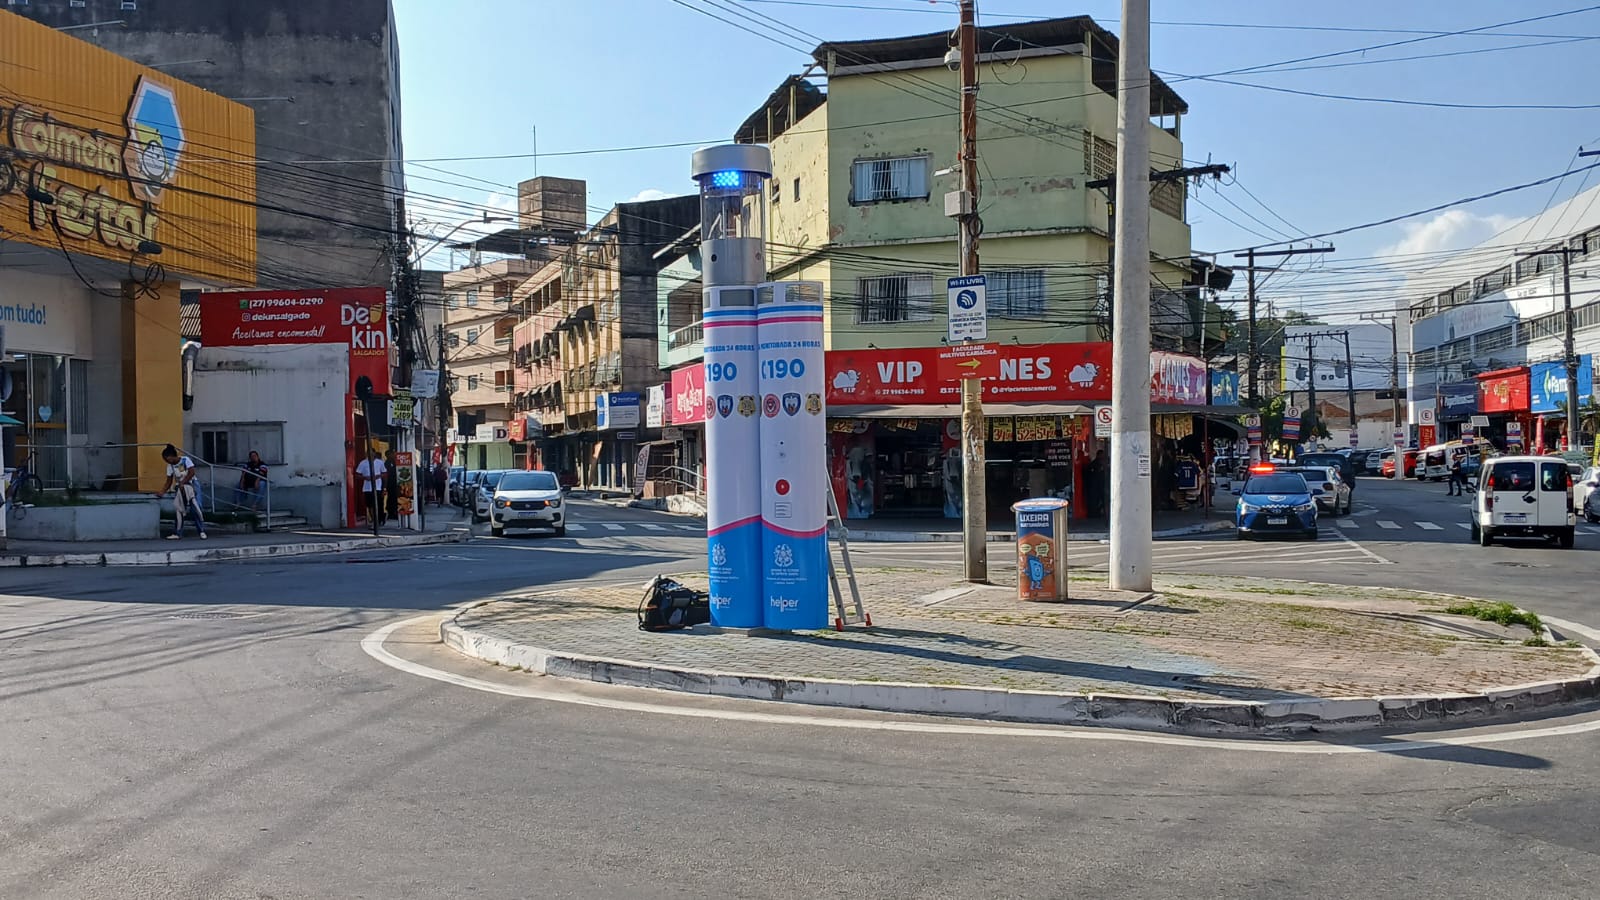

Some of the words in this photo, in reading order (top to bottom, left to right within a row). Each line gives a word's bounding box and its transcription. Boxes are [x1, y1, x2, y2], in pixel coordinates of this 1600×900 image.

[966, 277, 985, 285] LIVRE
[16, 302, 46, 325] tudo!
[352, 325, 385, 349] kin
[707, 362, 737, 382] 190
[767, 358, 805, 379] 190
[877, 360, 923, 384] VIP
[1019, 513, 1049, 522] LIXEIRA
[770, 596, 799, 613] helper
